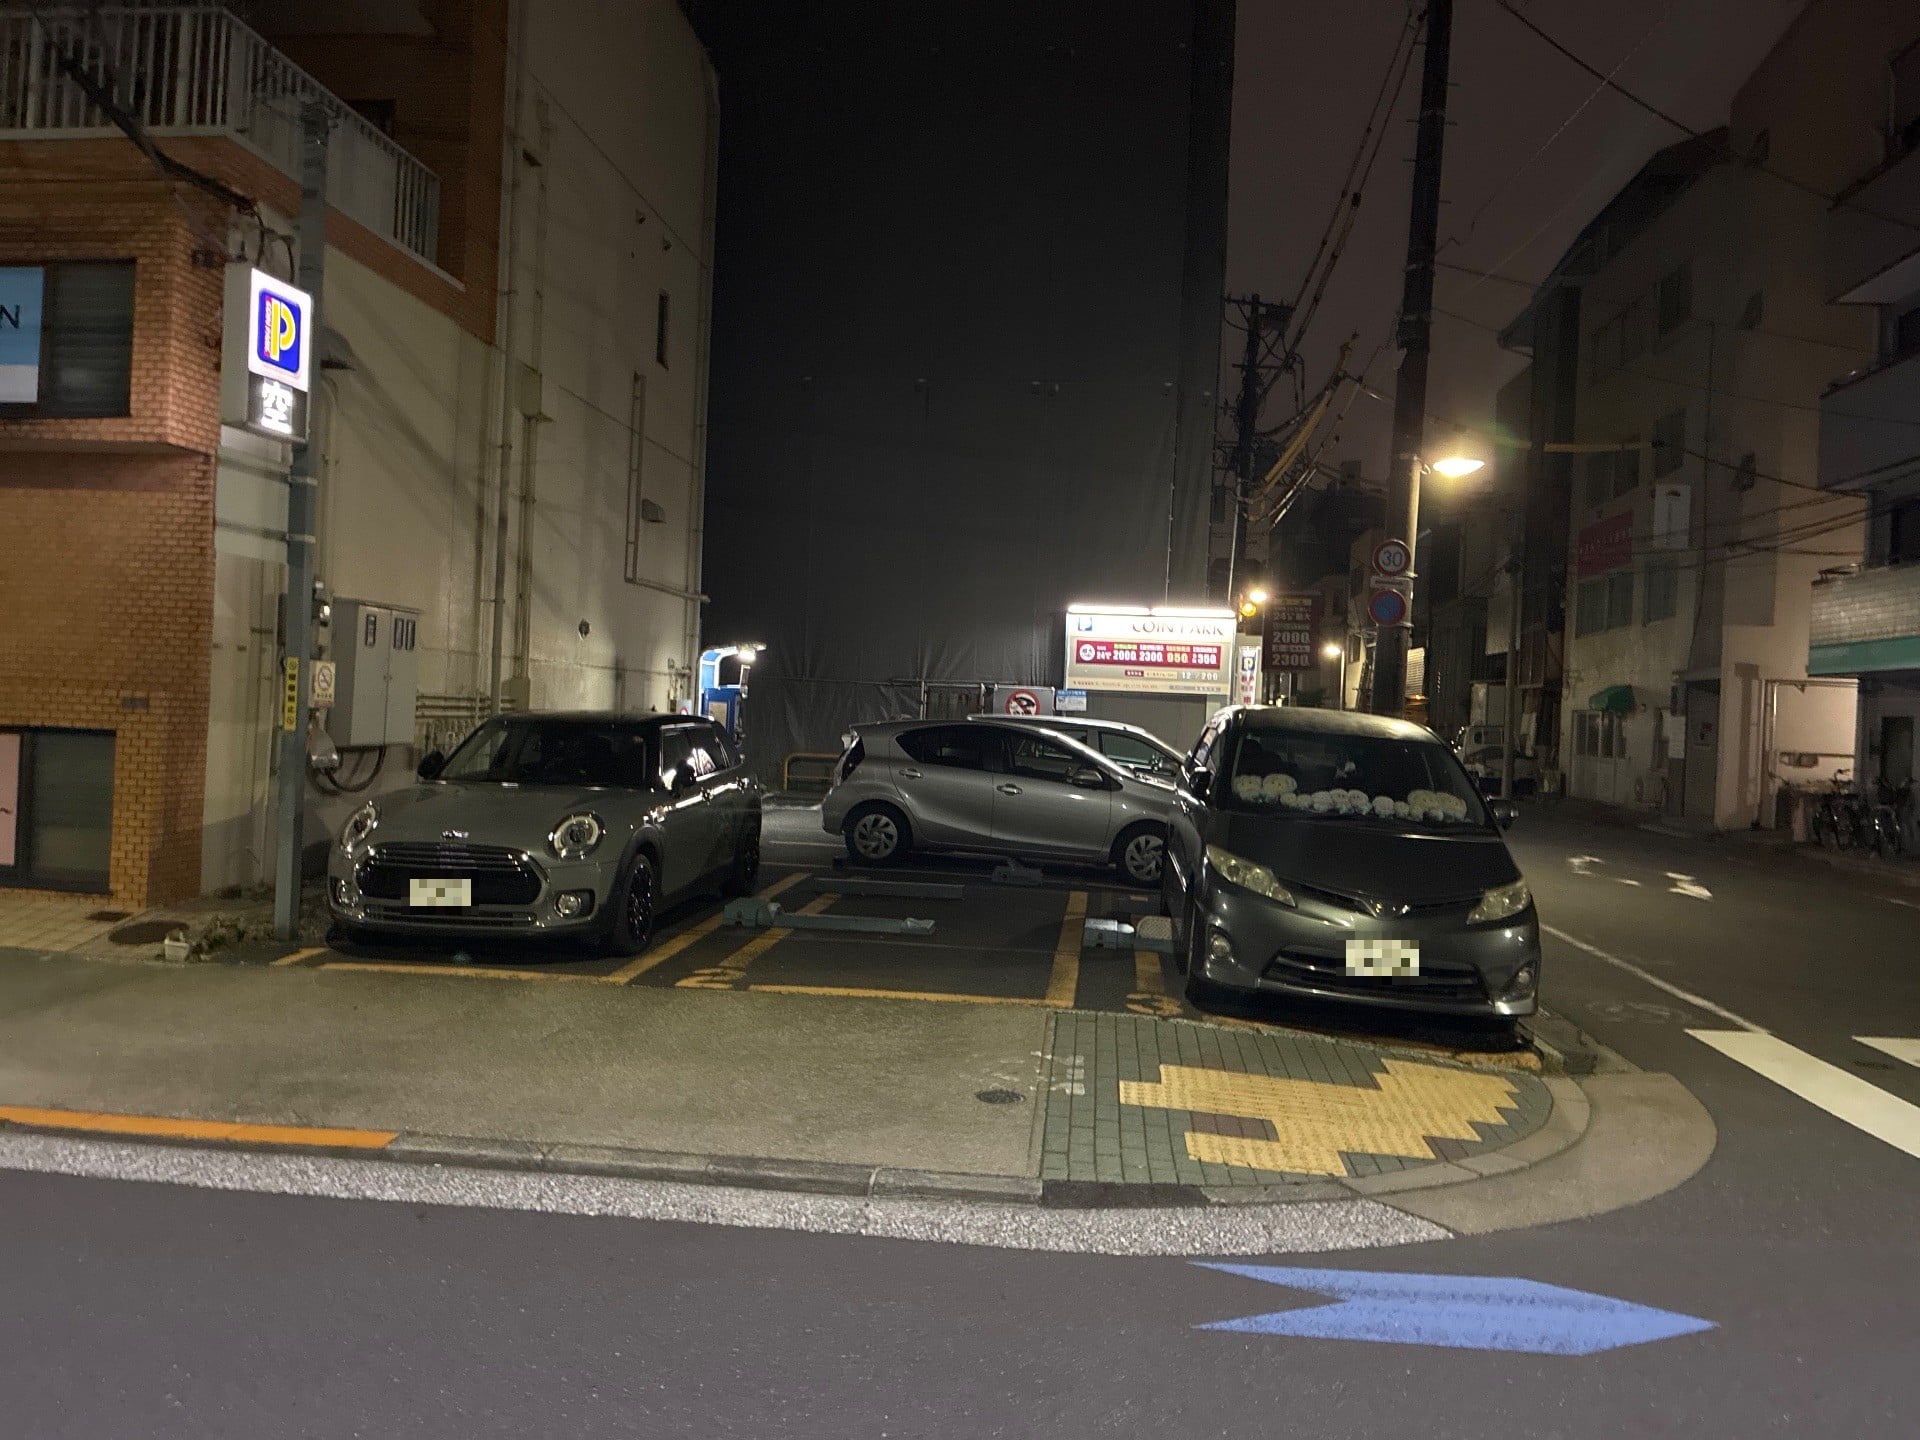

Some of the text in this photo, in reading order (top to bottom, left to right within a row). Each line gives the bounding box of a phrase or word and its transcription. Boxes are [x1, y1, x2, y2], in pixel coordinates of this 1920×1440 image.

[270, 297, 296, 362] P
[261, 381, 292, 433] 空
[1382, 551, 1402, 566] 30
